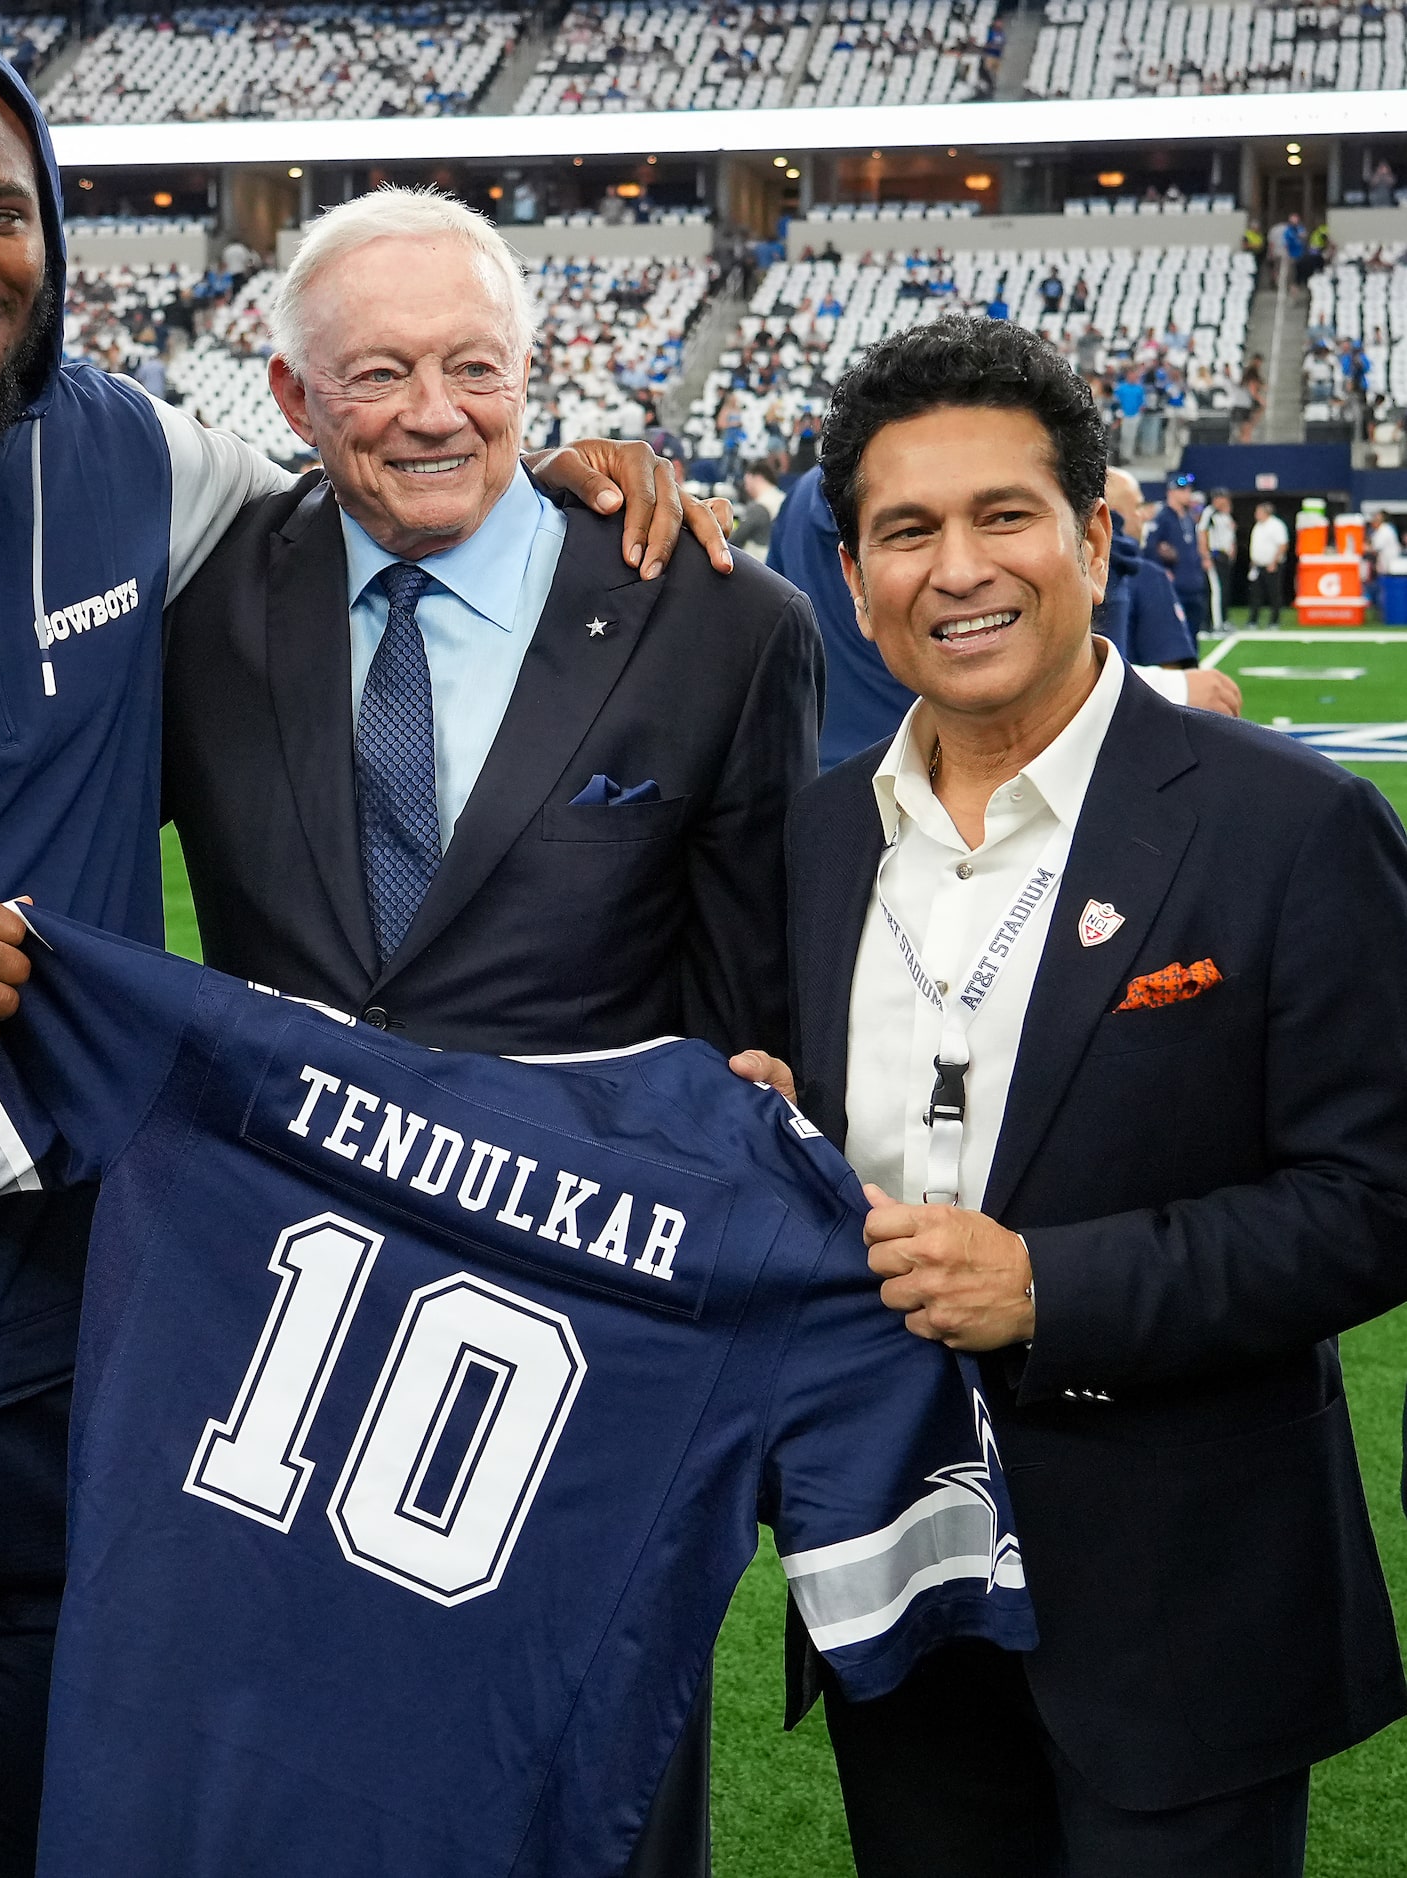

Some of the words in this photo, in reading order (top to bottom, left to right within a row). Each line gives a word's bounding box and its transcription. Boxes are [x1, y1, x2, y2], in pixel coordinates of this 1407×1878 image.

[960, 956, 999, 1011] AT&T
[988, 867, 1055, 958] STADIUM
[1086, 914, 1108, 933] NCL
[287, 1065, 687, 1281] TENDULKAR
[182, 1211, 588, 1607] 10
